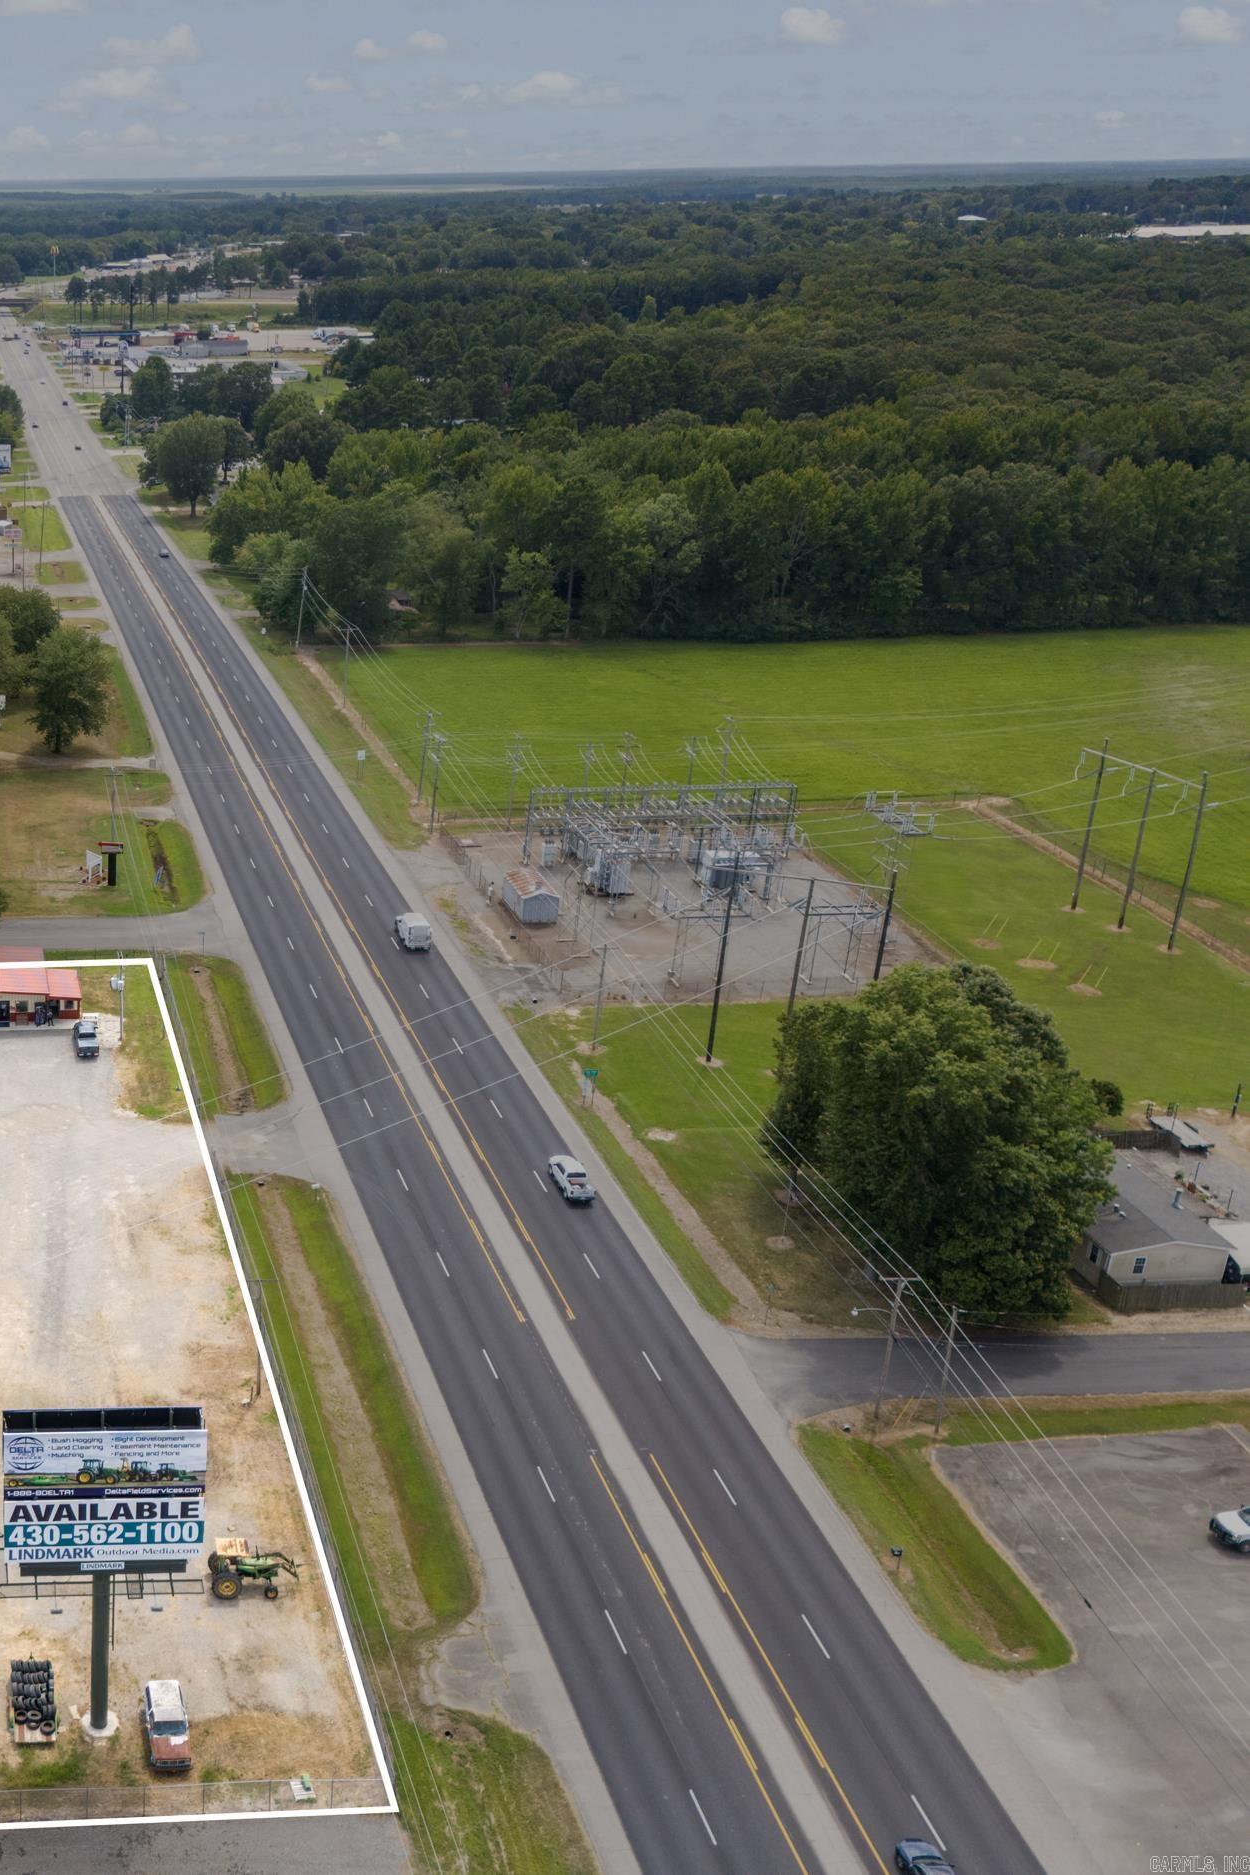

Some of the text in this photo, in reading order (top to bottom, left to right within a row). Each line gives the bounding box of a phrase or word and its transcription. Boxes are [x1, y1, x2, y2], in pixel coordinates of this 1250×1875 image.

[9, 1446, 44, 1454] DELTA
[104, 1487, 202, 1496] DeltaFieldServices.com
[9, 1501, 199, 1523] AVAILABLE
[8, 1522, 199, 1546] 430-562-1100
[8, 1547, 199, 1561] LINDMARK Outdoor Media.com
